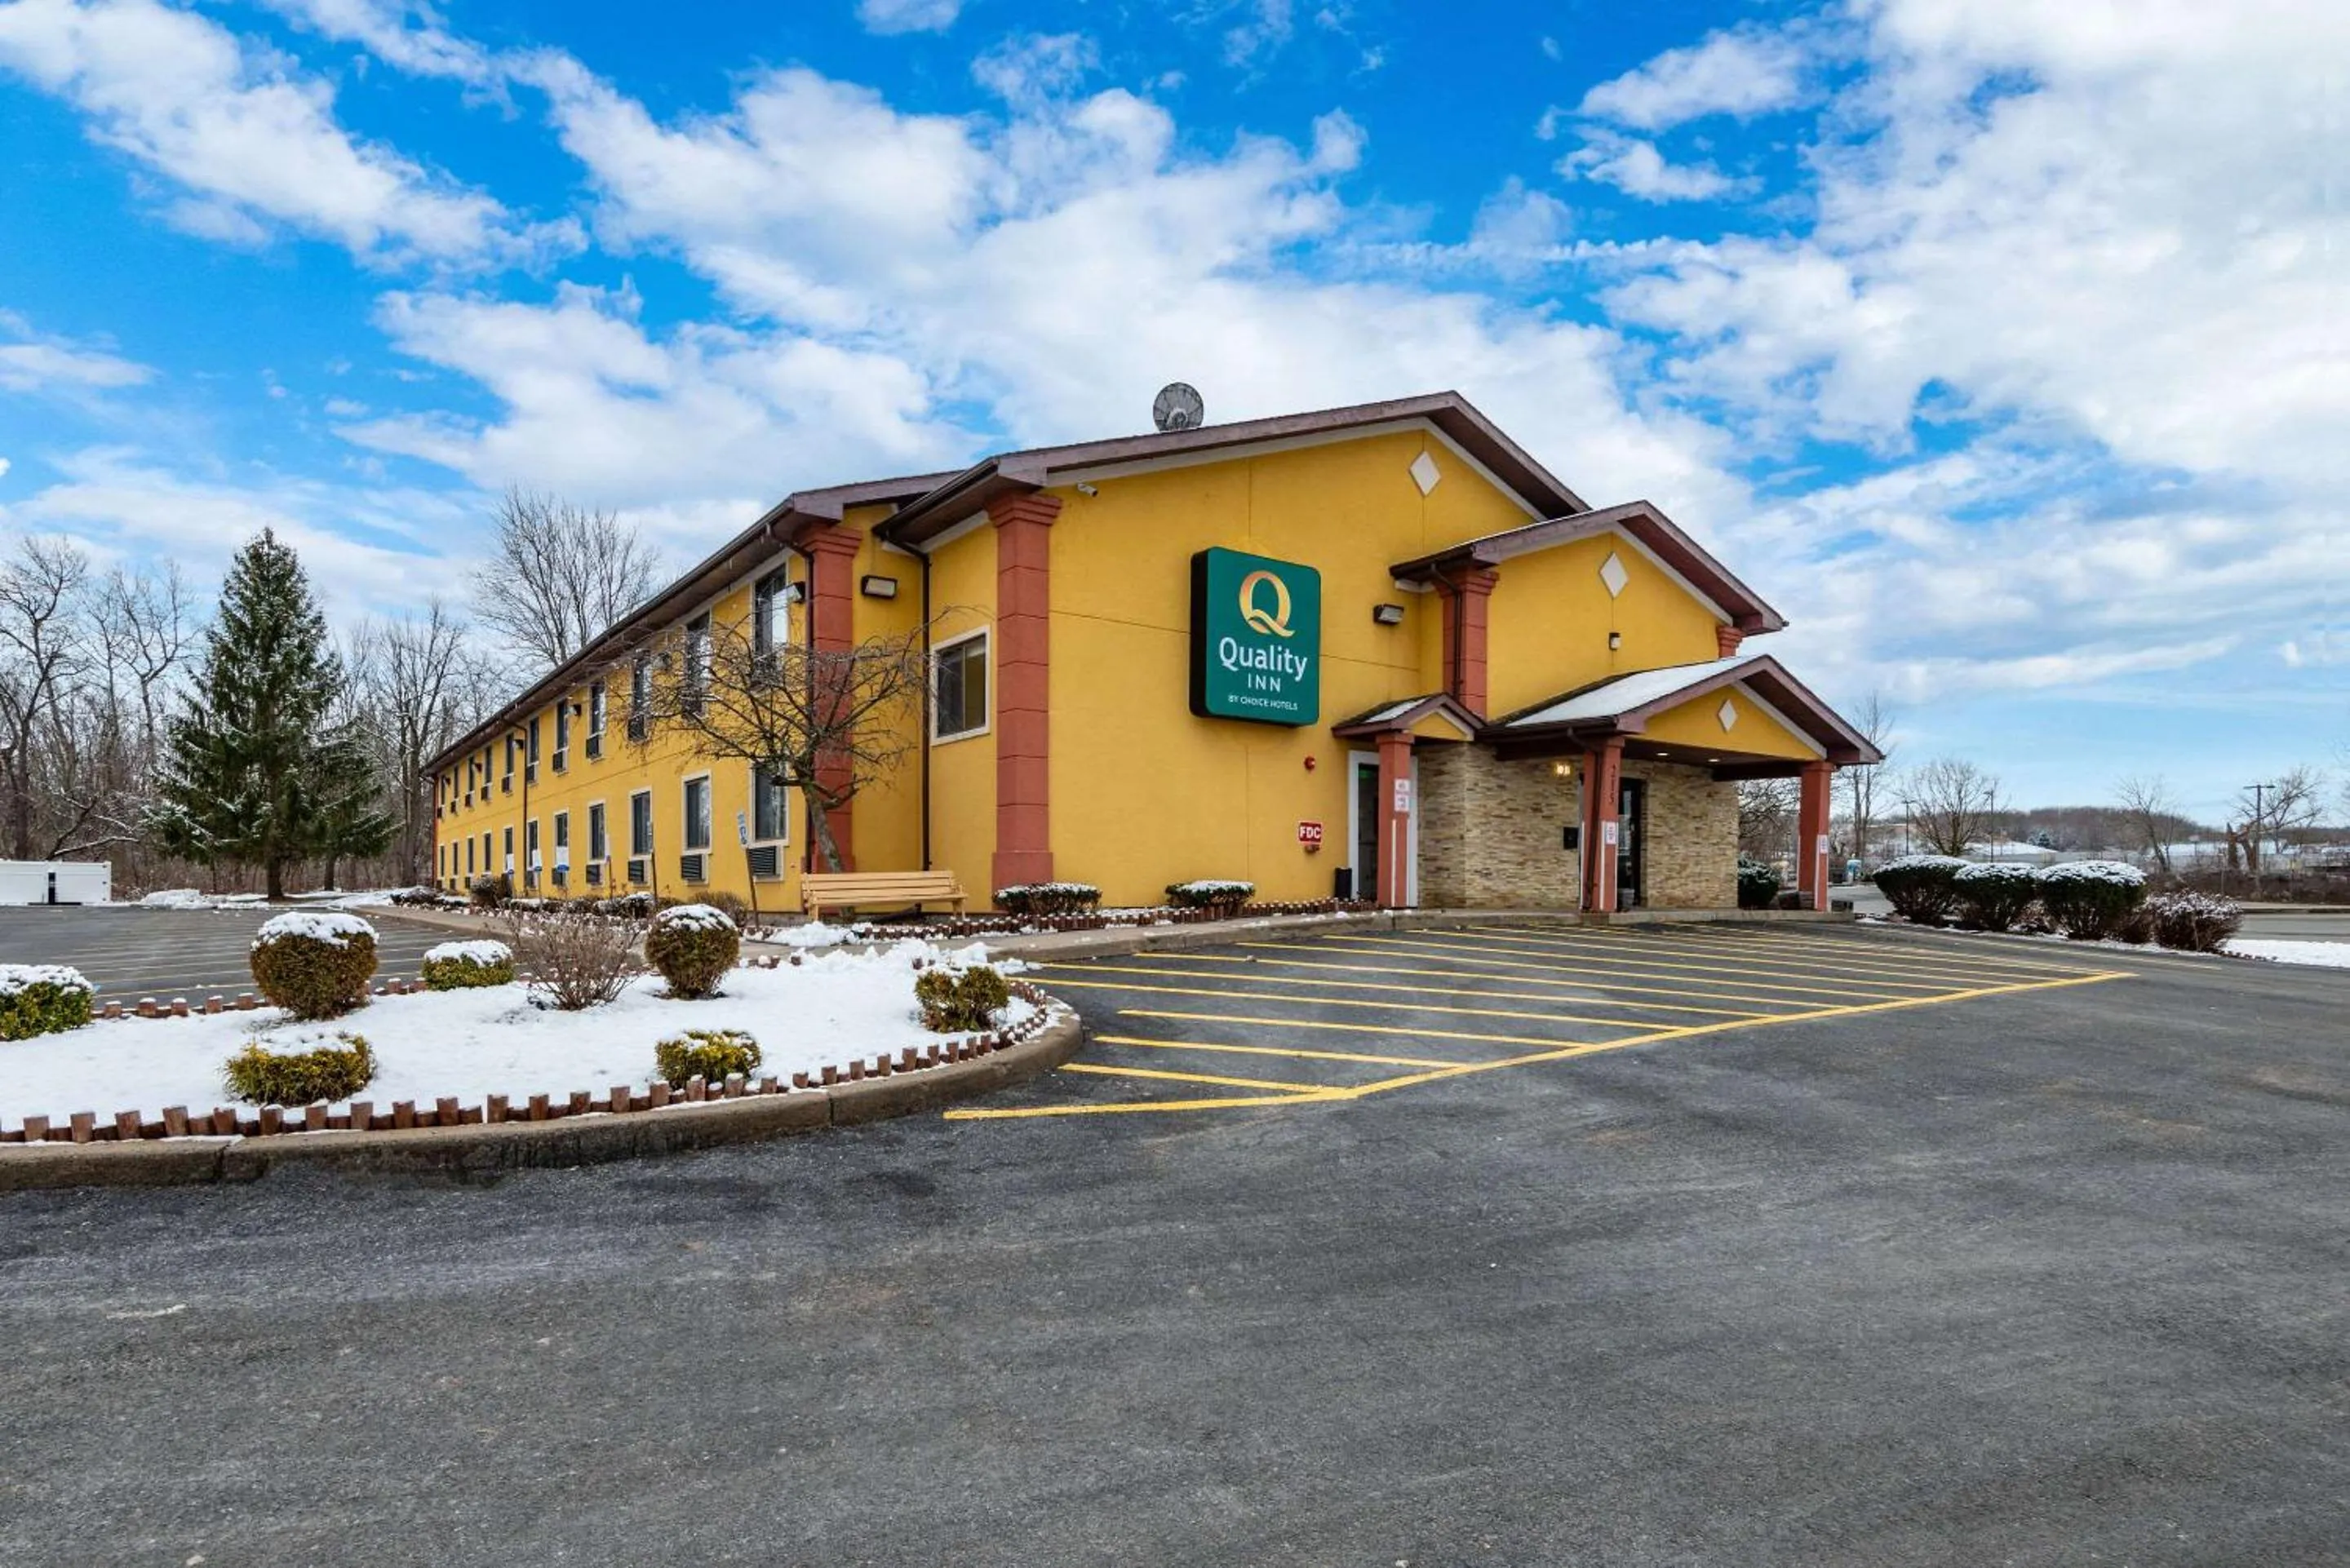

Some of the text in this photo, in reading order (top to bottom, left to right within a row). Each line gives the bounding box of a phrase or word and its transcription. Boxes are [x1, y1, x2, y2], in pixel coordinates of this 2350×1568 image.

[1239, 570, 1296, 637] Q
[1219, 636, 1308, 682] Quality
[1248, 673, 1281, 693] INN
[1228, 694, 1298, 711] BY CHOICE HOTELS
[1299, 826, 1322, 839] FDC
